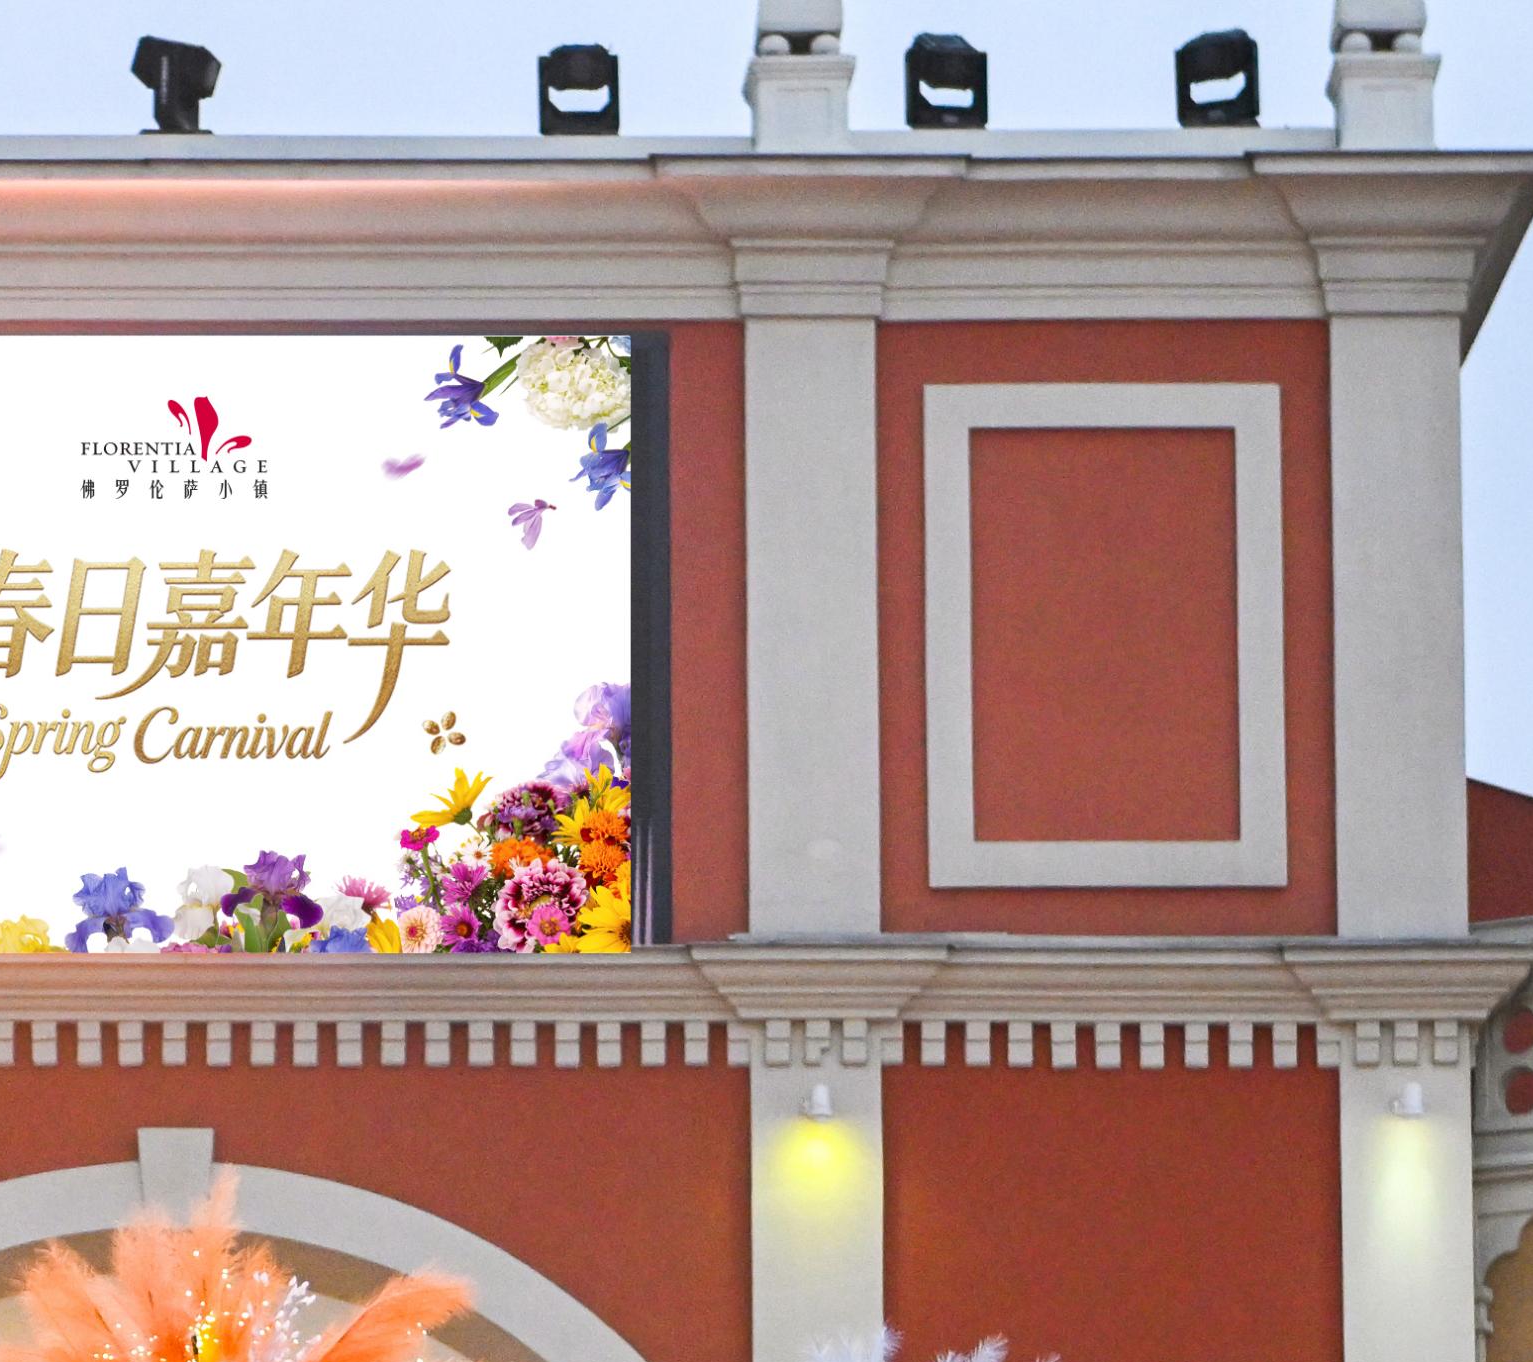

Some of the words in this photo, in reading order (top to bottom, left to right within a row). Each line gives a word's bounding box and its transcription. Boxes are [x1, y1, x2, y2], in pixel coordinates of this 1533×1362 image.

[80, 441, 197, 456] FLORENTIA
[127, 459, 268, 474] VILLAGE
[80, 479, 269, 500] 佛罗伦萨小镇
[132, 705, 334, 764] Carnival
